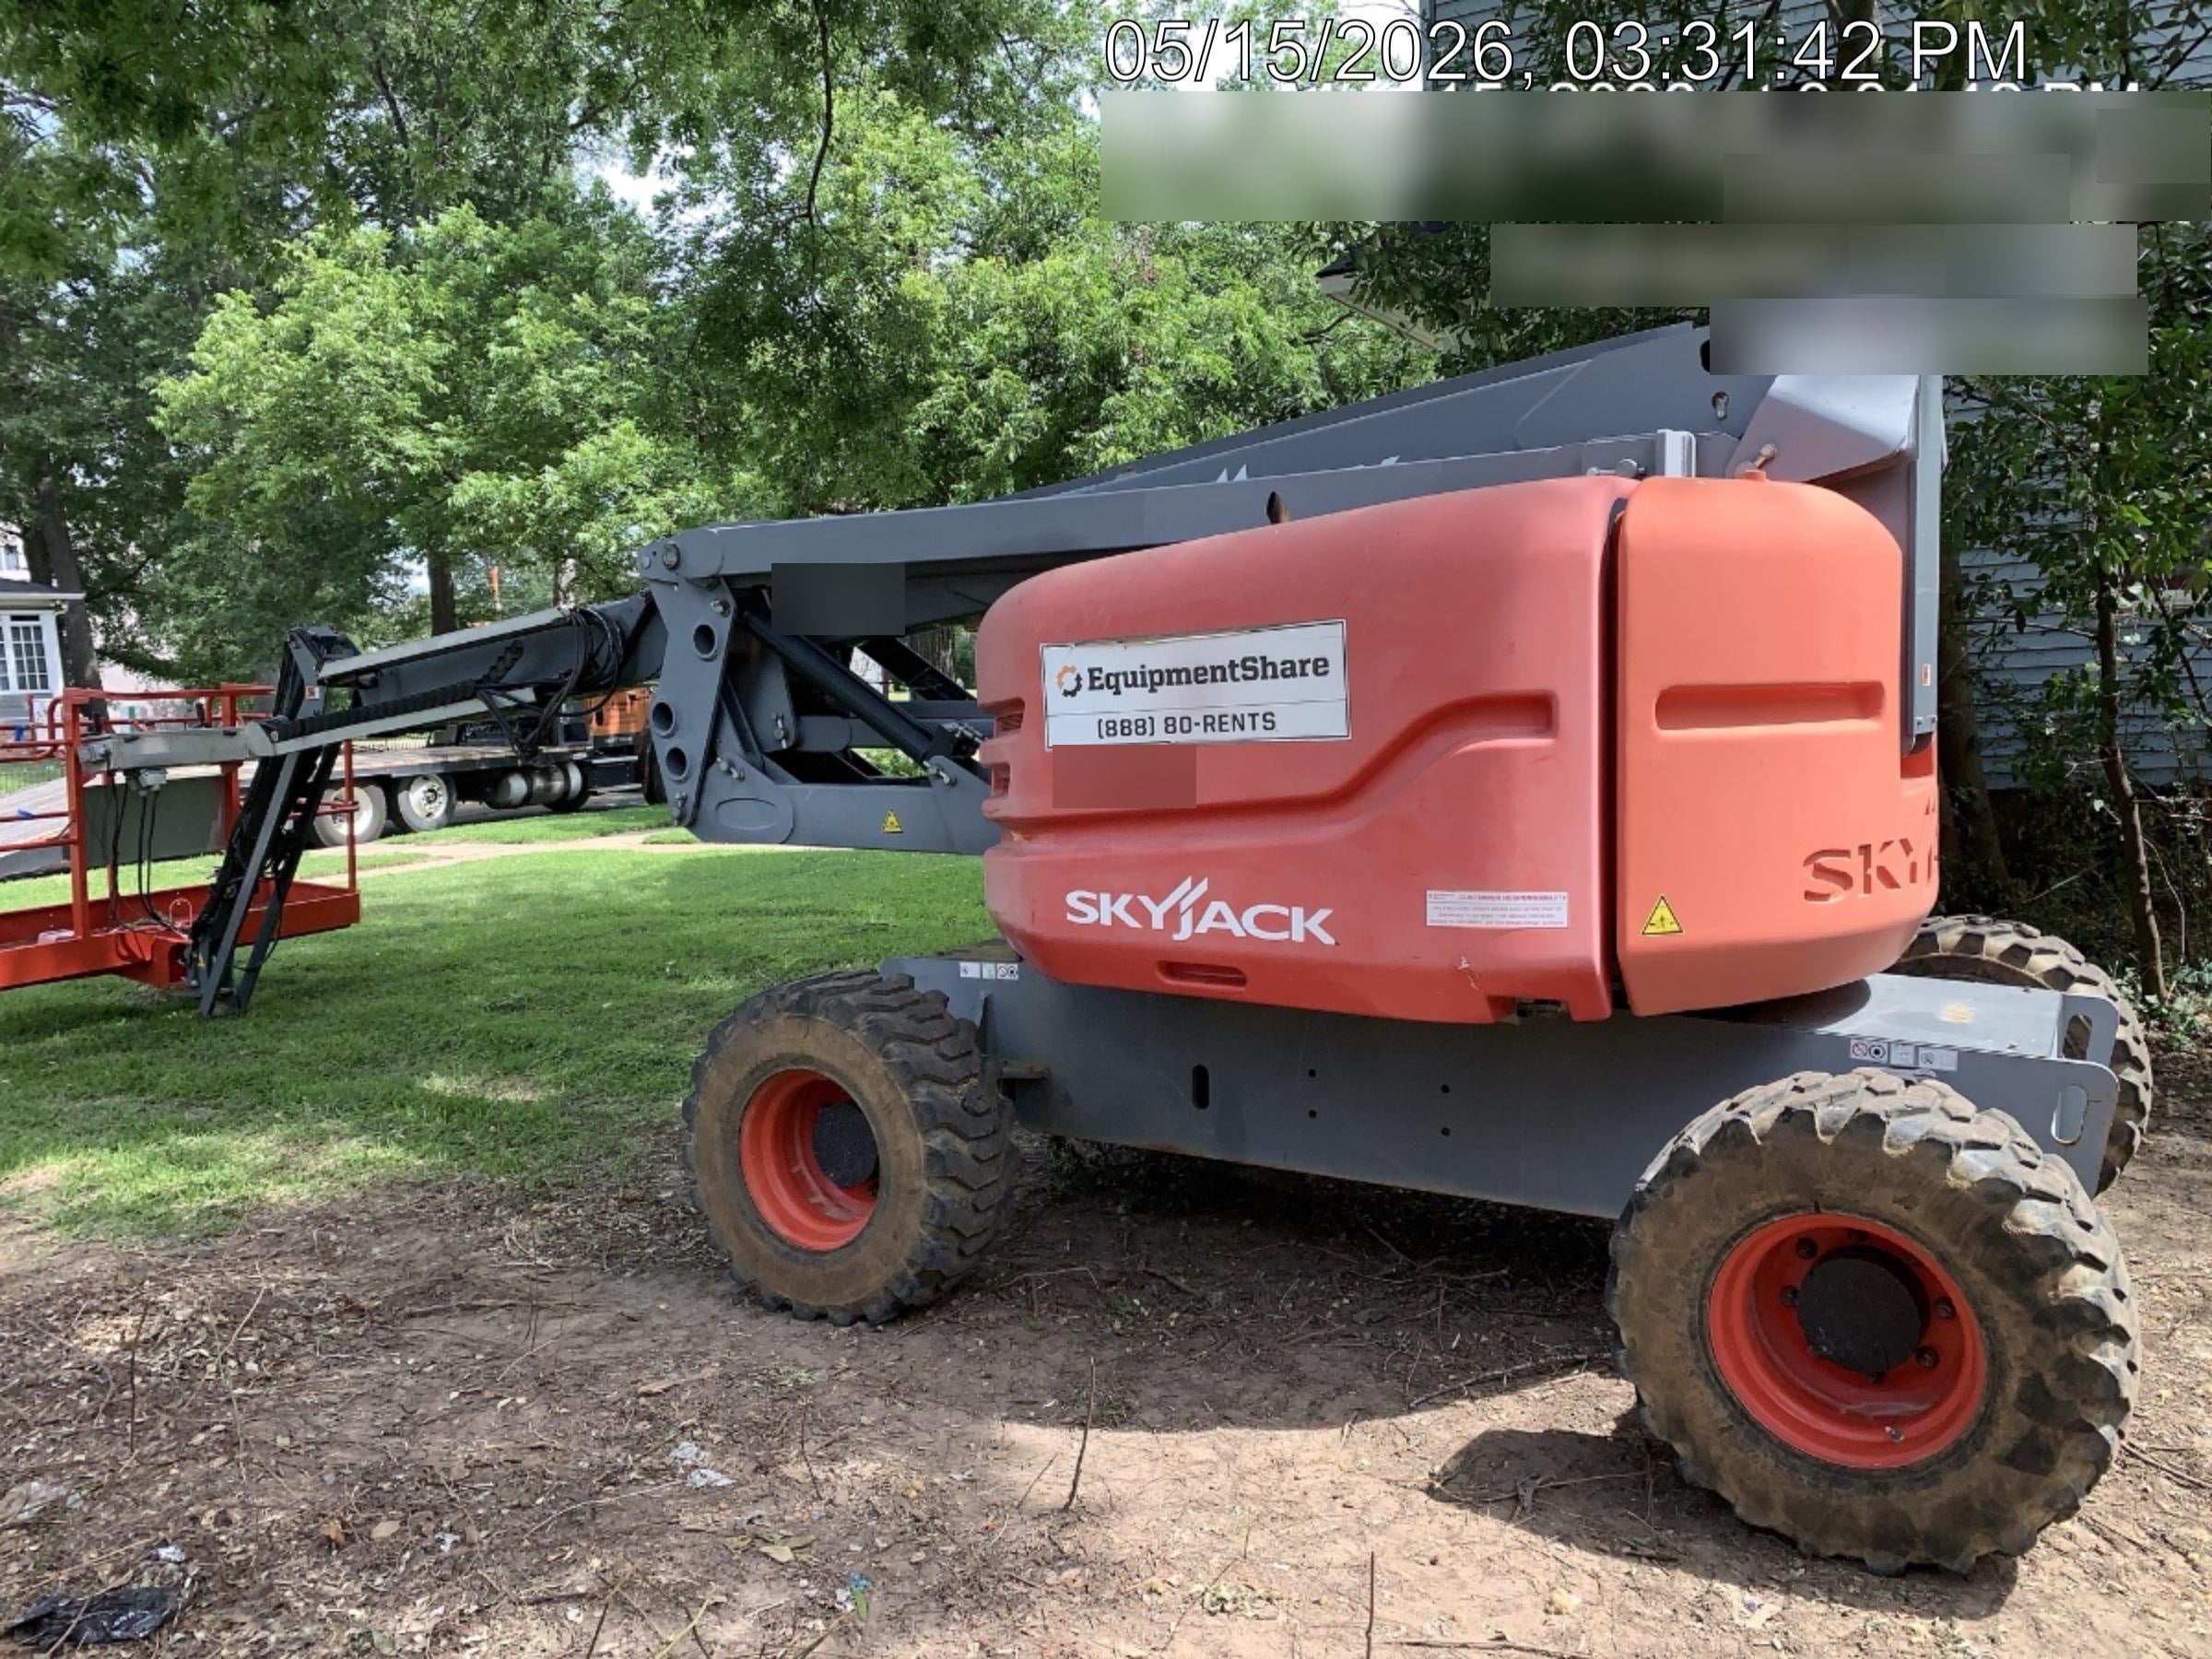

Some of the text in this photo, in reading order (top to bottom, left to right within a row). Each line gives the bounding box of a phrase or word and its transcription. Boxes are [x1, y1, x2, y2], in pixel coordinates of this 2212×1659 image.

[1087, 655, 1330, 695] EquipmentShare
[1164, 711, 1277, 735] 80-RENTS
[1065, 876, 1335, 946] SKYJACK
